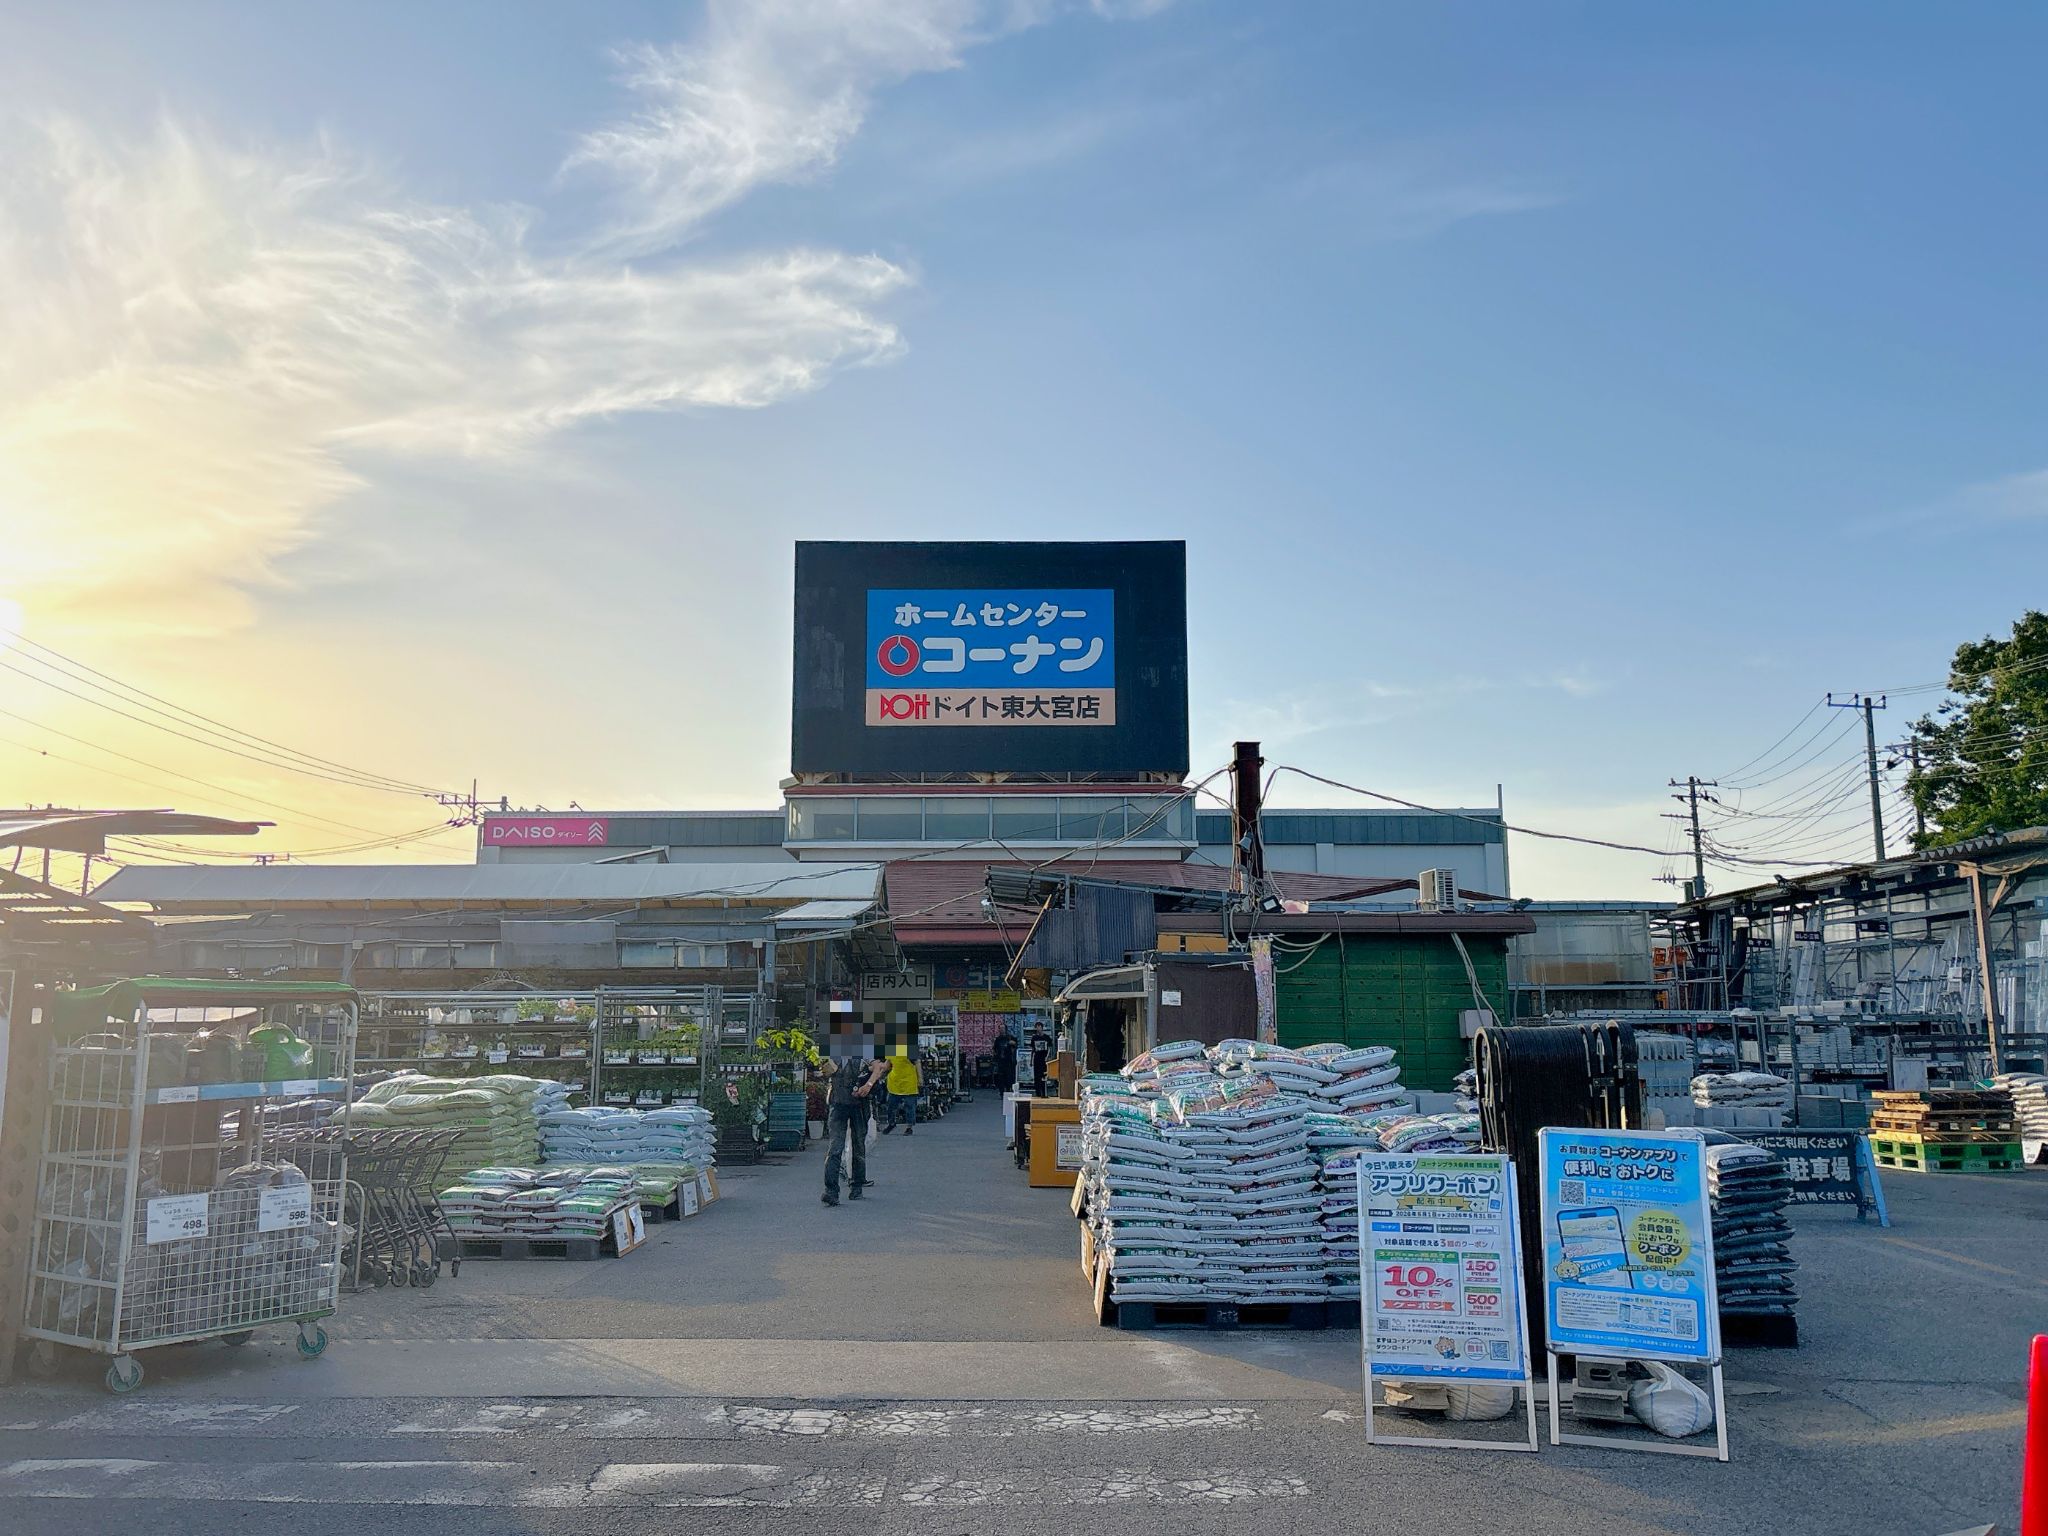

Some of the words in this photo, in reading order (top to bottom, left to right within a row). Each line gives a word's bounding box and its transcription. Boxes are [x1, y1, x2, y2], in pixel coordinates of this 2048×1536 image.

[894, 602, 1087, 627] ホームセンター
[922, 634, 1104, 674] コーナン
[933, 695, 1100, 720] ドイト東大宮店
[492, 826, 556, 839] DAISO
[866, 974, 928, 988] 店内入口
[1560, 1145, 1598, 1155] お買物は
[1600, 1146, 1678, 1163] コーナンアプリ
[1616, 1163, 1674, 1181] おトクに
[1370, 1173, 1498, 1196] アプリクーポン
[288, 1210, 306, 1221] 598
[182, 1219, 202, 1230] 498
[1638, 1223, 1681, 1235] 会員登録で
[1637, 1242, 1682, 1256] クーポン
[1465, 1260, 1497, 1272] 150
[1580, 1258, 1612, 1273] SAMPLE
[1384, 1265, 1454, 1288] 10%
[1395, 1288, 1442, 1298] OFF
[1466, 1294, 1498, 1306] 500
[1393, 1300, 1445, 1310] クーポン
